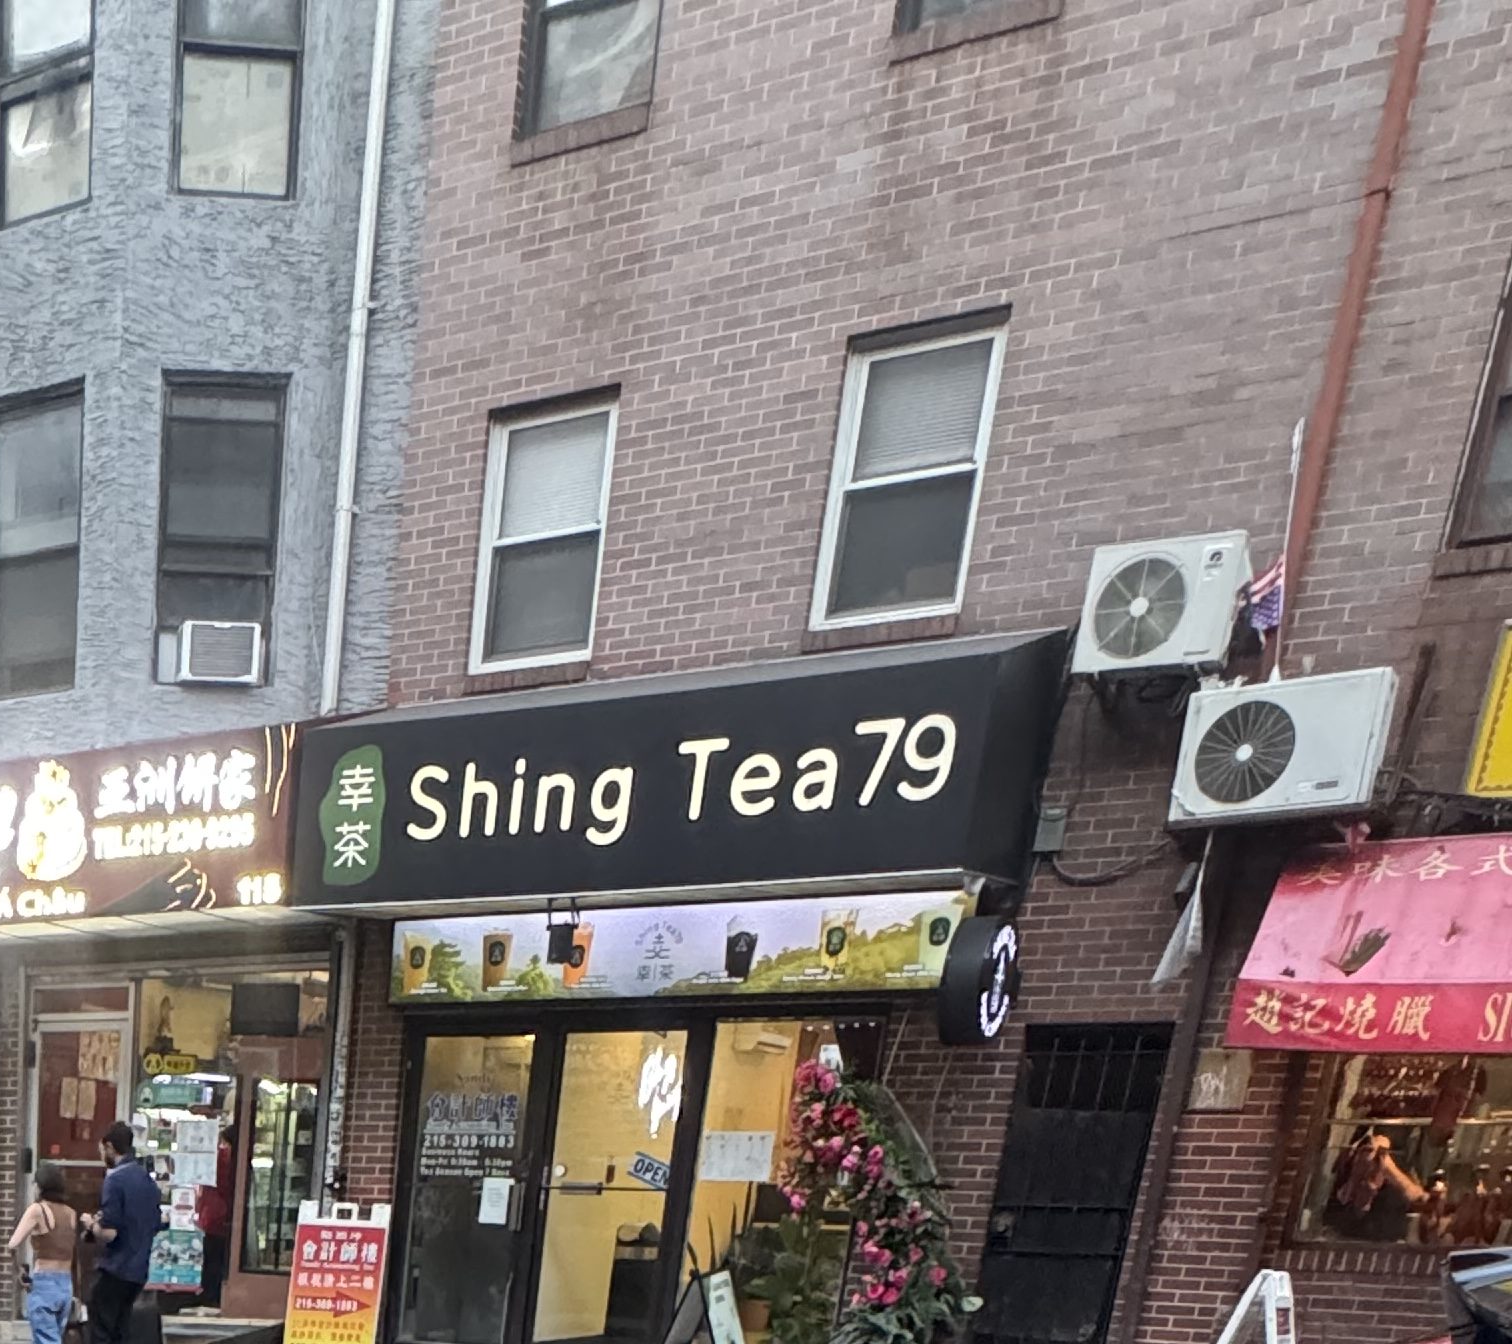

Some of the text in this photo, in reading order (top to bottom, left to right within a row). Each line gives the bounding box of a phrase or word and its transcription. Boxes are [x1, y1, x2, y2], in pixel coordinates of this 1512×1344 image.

[332, 763, 377, 868] 幸茶
[405, 756, 636, 847] Shing
[633, 1158, 670, 1186] OPEN
